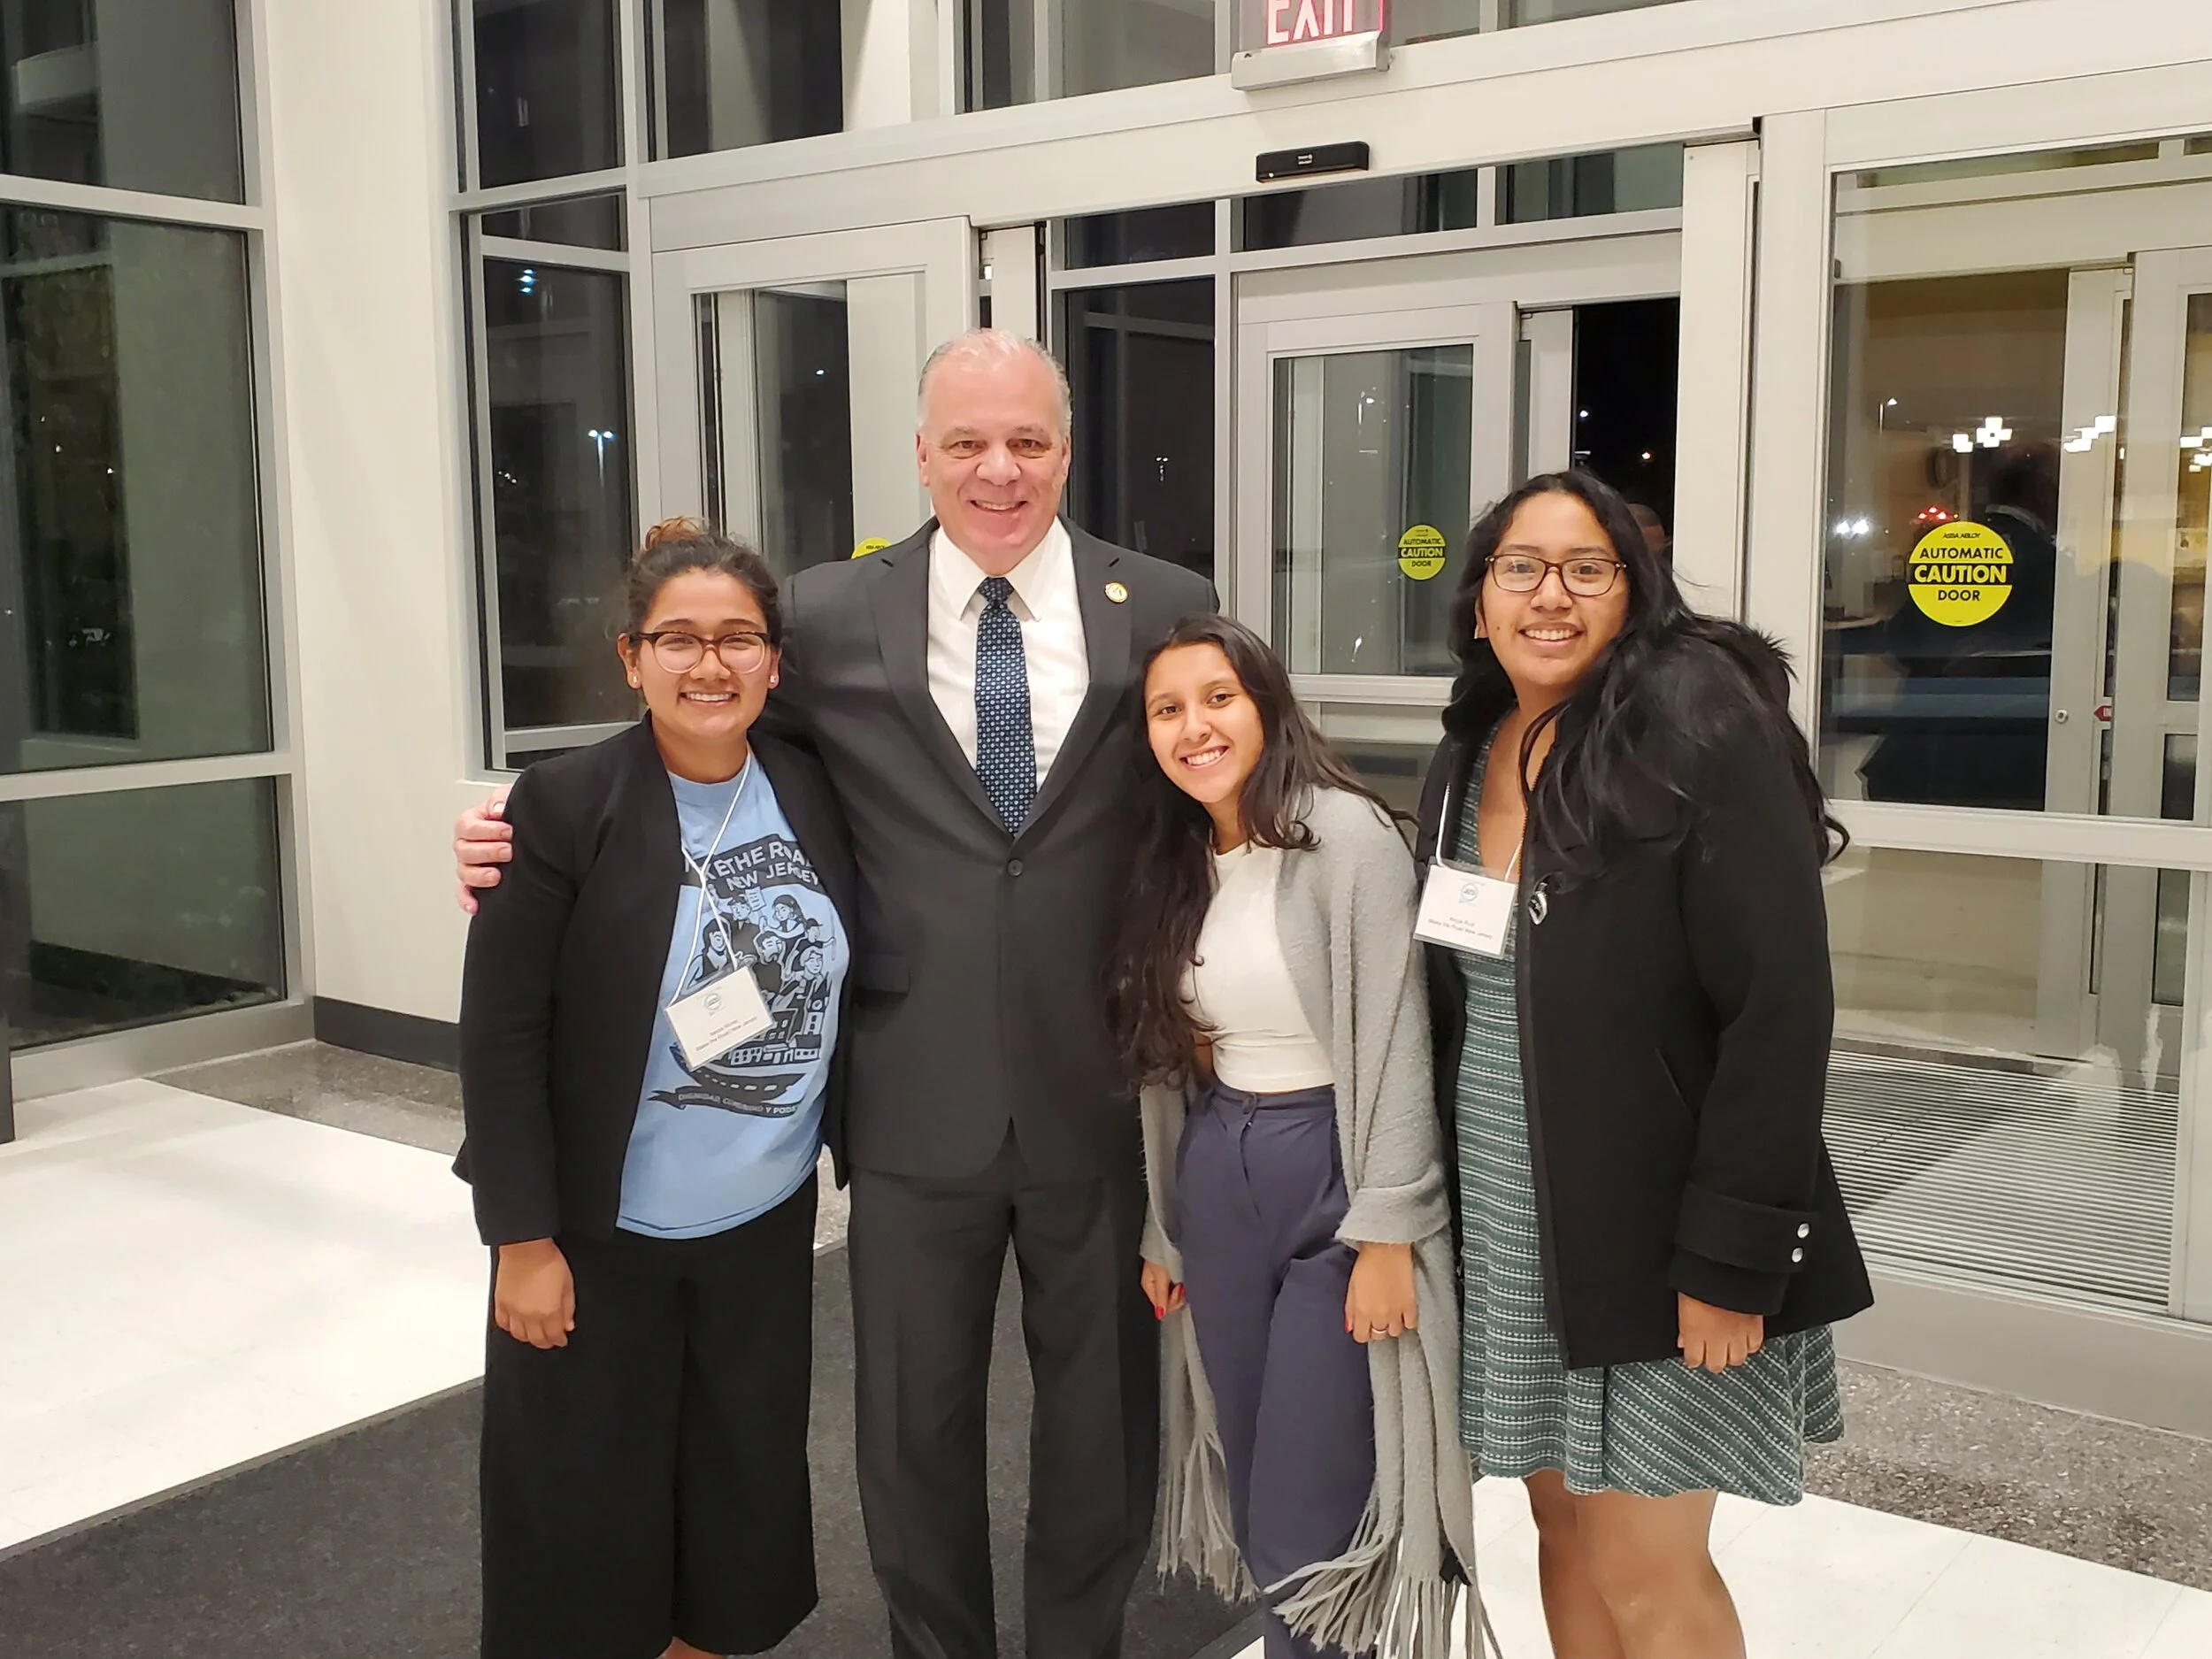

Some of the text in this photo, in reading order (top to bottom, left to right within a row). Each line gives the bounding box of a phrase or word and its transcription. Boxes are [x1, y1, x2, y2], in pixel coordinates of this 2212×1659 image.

[1401, 548, 1443, 557] CAUTION
[1919, 548, 2003, 559] AUTOMATIC
[1914, 565, 2007, 583] CAUTION
[1938, 589, 1980, 602] DOOR
[725, 846, 766, 875] THE
